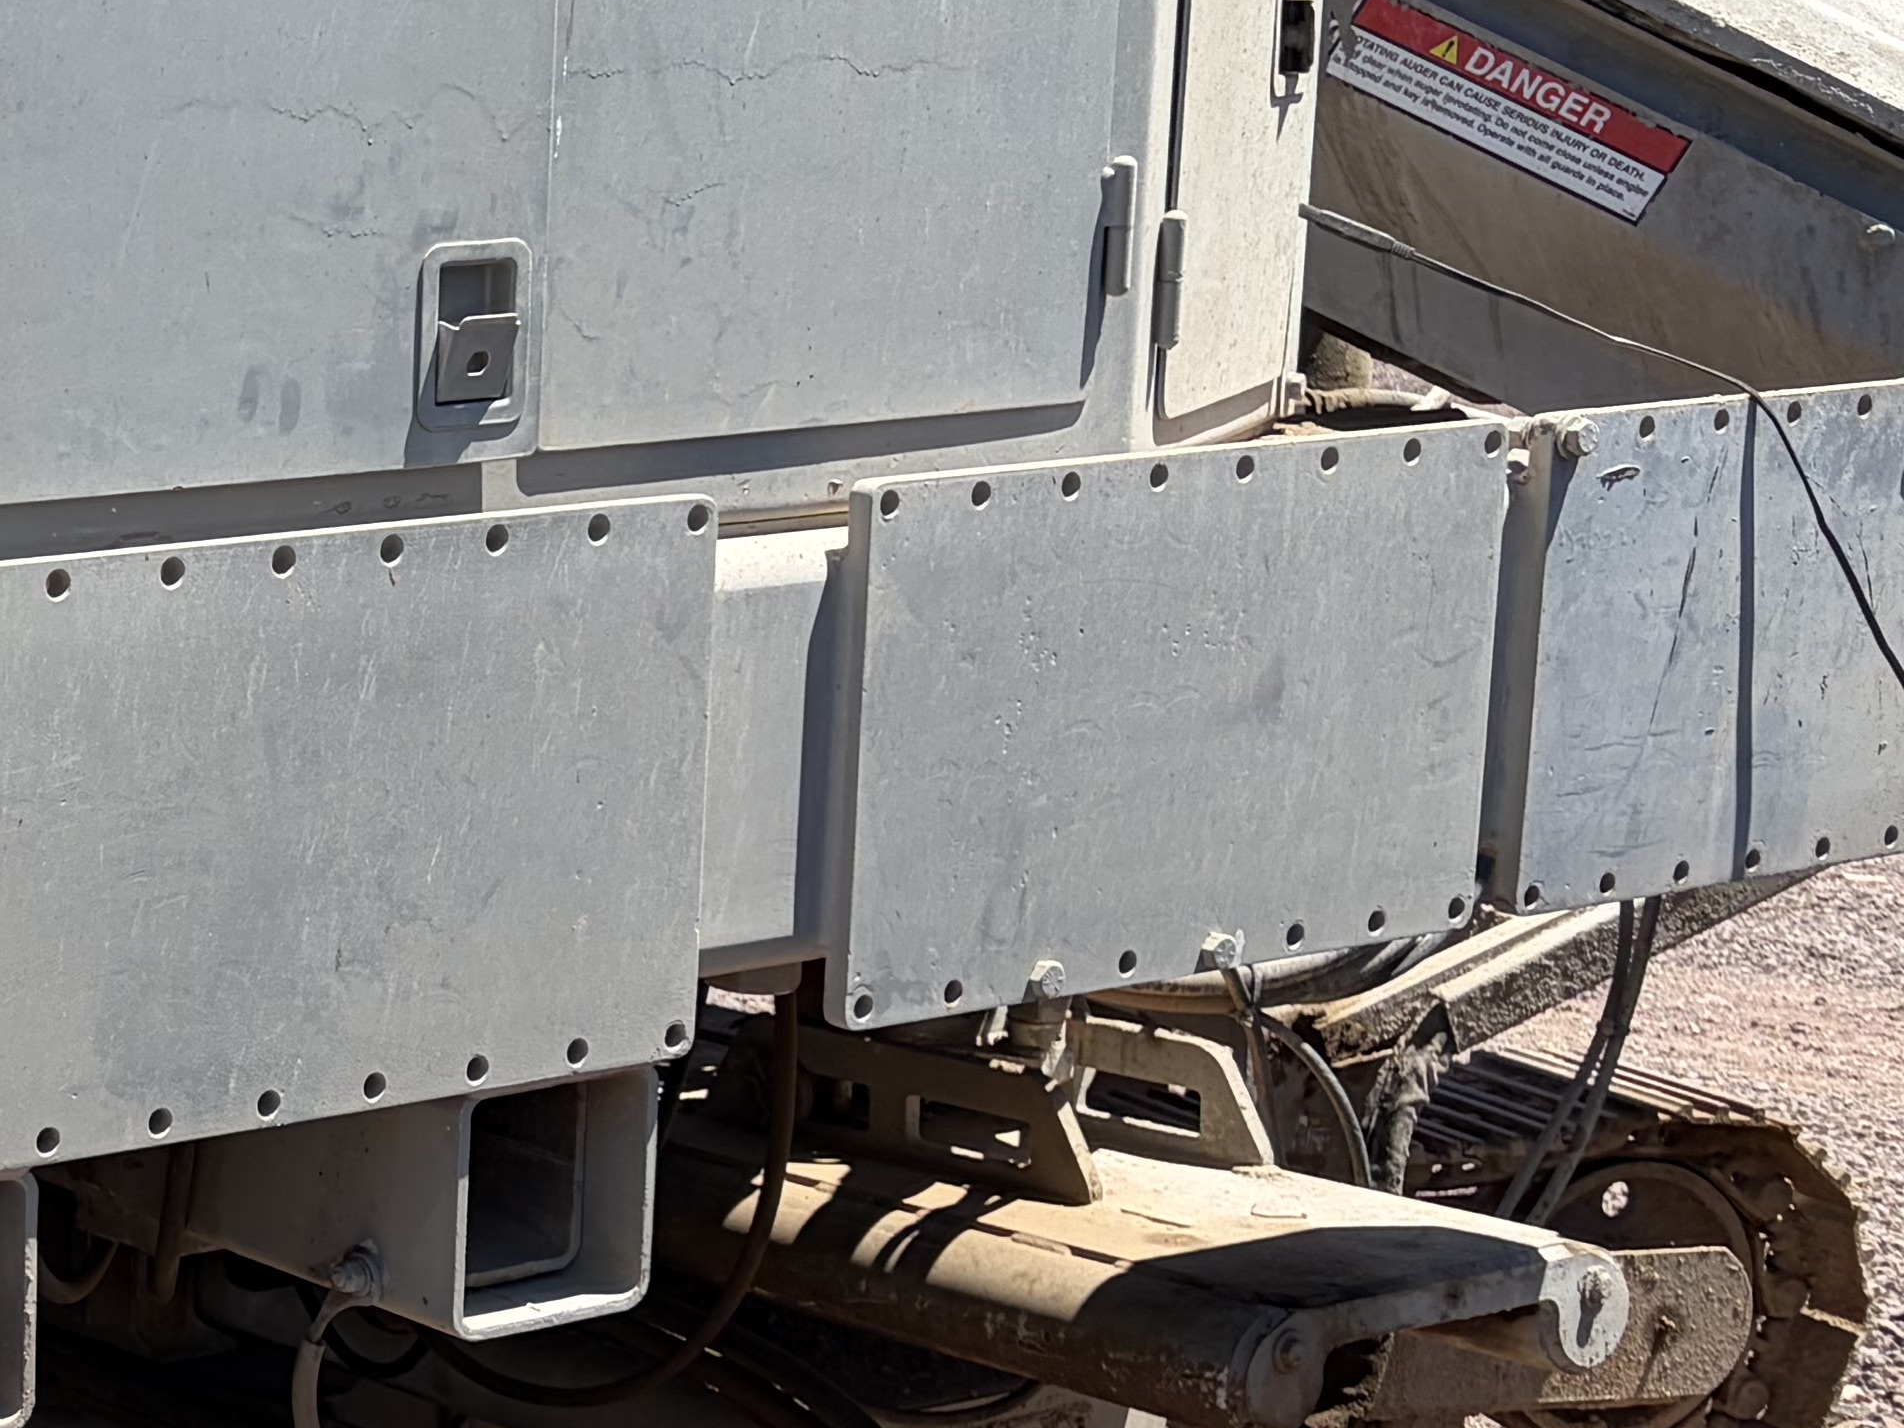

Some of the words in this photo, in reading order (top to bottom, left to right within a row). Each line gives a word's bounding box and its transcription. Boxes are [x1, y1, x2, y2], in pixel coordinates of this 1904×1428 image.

[1343, 60, 1382, 84] topped
[1383, 78, 1402, 93] and
[1402, 88, 1421, 104] key
[1476, 123, 1515, 148] Operate
[1516, 143, 1537, 157] with
[1538, 153, 1551, 164] all
[1551, 160, 1585, 182] guards
[1585, 176, 1596, 186] in
[1596, 182, 1626, 202] place.
[1355, 35, 1399, 62] OTATING
[1399, 57, 1438, 81] AUGER
[1438, 75, 1463, 93] CAN
[1463, 87, 1501, 111] CAUSE
[1501, 106, 1549, 134] SERIOUS
[1550, 129, 1589, 153] INJURY
[1590, 148, 1607, 162] OR
[1608, 157, 1647, 181] DEATH.
[1362, 54, 1386, 71] clear
[1387, 66, 1414, 84] when
[1413, 80, 1442, 99] auger
[1494, 117, 1510, 130] Do
[1510, 125, 1527, 138] not
[1528, 134, 1554, 151] come
[1555, 147, 1582, 164] close
[1583, 160, 1615, 181] unless
[1615, 177, 1648, 199] engine
[1464, 46, 1612, 135] DANGER
